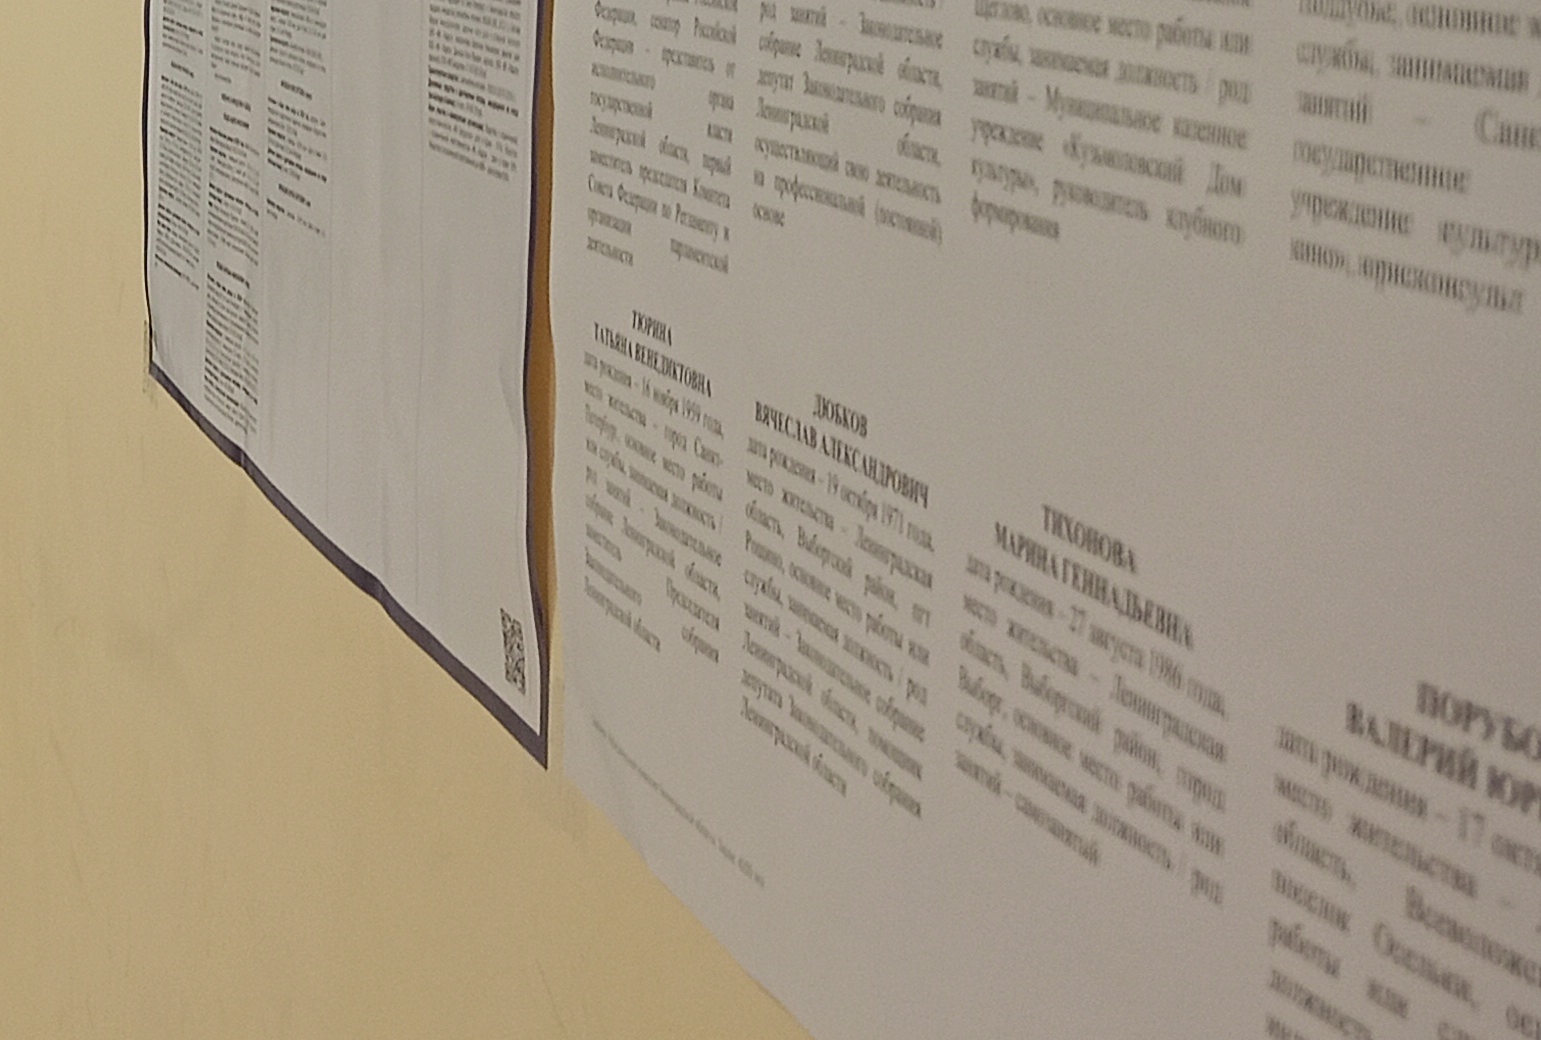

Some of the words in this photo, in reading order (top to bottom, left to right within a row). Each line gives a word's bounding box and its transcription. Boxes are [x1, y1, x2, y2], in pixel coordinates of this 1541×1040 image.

[594, 322, 633, 359] ТАТЬЯНА
[634, 342, 712, 397] ВЕНЕДИКТОВНА
[632, 310, 672, 346] ТЮРИНА
[813, 393, 868, 438] ДЮБКОВ
[755, 400, 817, 449] ВЯЧЕСЛАВ
[821, 434, 930, 509] АЛЕКСАНДРОВИЧ
[1041, 503, 1137, 575] ТИХОНОВА
[994, 520, 1058, 582] МАРИНА
[1061, 557, 1194, 652] ГЕННАДЬЕВНА
[1345, 701, 1479, 791] ВАЛЕРИЙ
